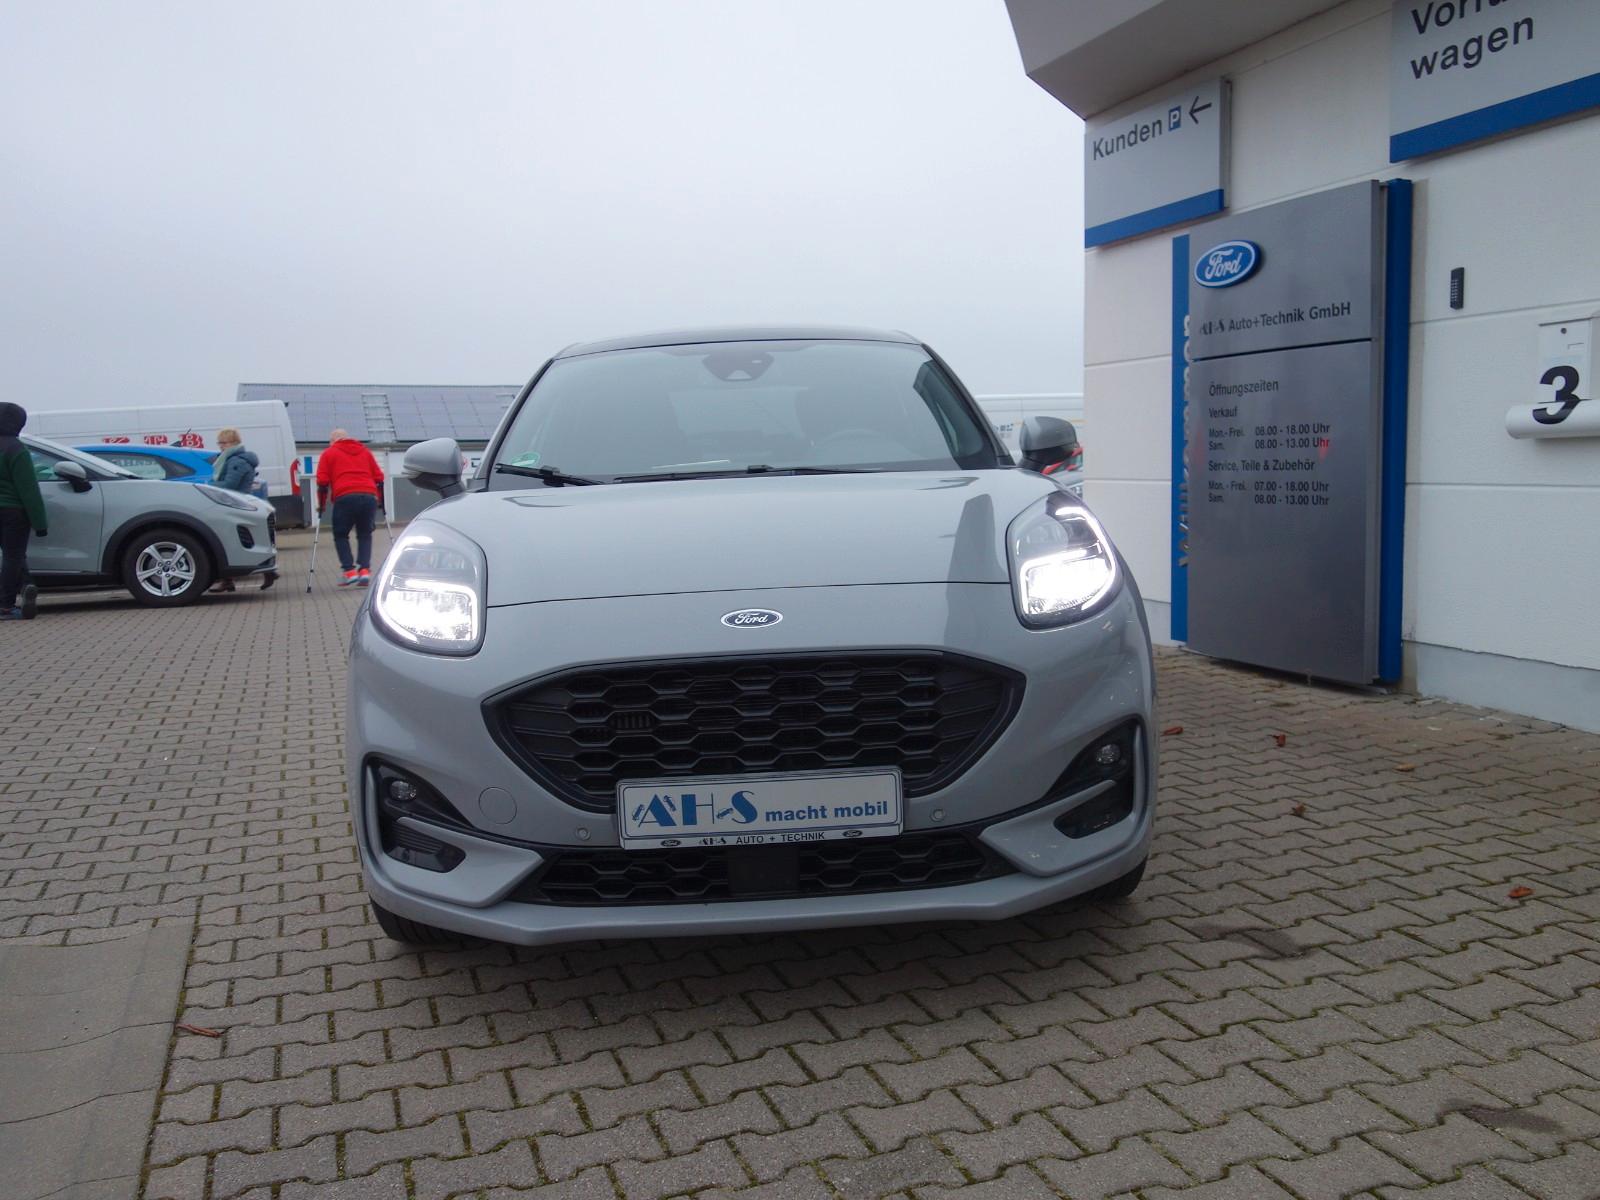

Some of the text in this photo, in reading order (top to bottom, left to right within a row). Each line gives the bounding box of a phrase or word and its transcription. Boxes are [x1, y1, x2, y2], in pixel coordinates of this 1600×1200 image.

[1411, 0, 1508, 34] Vor
[1410, 17, 1534, 79] wagen
[1093, 119, 1163, 160] Kunden
[1204, 248, 1243, 279] Ford
[1228, 308, 1304, 332] Auto+Technik
[1309, 302, 1351, 320] GmbH
[1208, 380, 1279, 397] Öffnungszeiten
[1532, 365, 1580, 425] 3
[1208, 406, 1238, 418] Verkauf
[1286, 424, 1310, 435] 18.00
[1312, 424, 1330, 434] Uhr
[1255, 439, 1277, 449] 08.00
[1286, 438, 1310, 448] 13.00
[1312, 437, 1329, 447] Uhr
[1208, 459, 1315, 472] Service, Teile & Zubehör
[1254, 481, 1277, 491] 07.00
[1285, 482, 1309, 492] 18.00
[1312, 481, 1329, 492] Uhr
[1254, 494, 1277, 504] 08.00
[1285, 495, 1309, 505] 13.00
[1312, 495, 1329, 505] Uhr
[734, 612, 769, 624] Ford
[635, 790, 889, 827] AHS macht mobil
[736, 834, 764, 846] AUTO
[780, 831, 825, 843] TECHNIK
